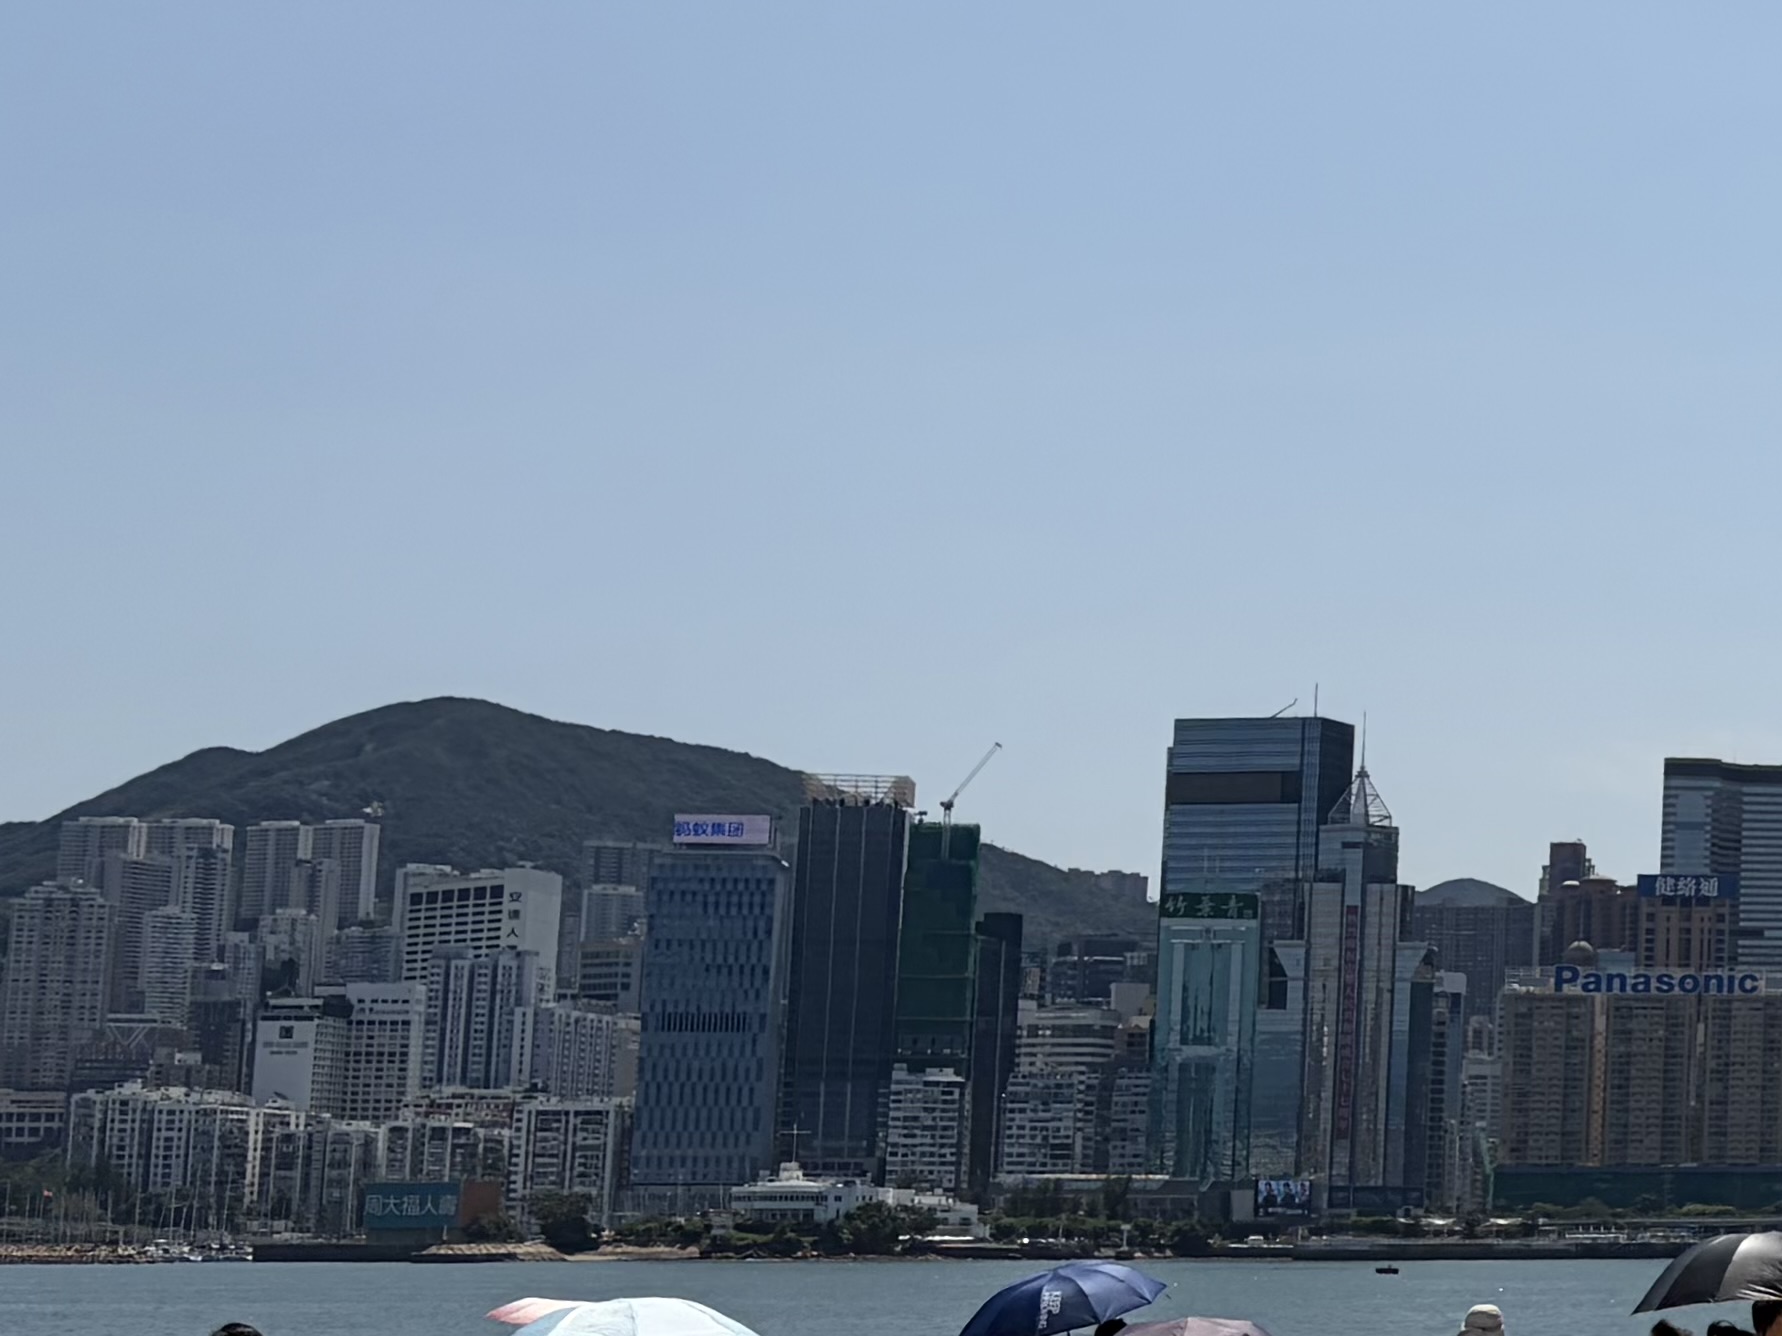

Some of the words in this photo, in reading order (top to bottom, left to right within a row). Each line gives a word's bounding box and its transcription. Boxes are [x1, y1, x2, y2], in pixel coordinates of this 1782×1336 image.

[675, 821, 743, 837] 蚂蚁集团
[1554, 965, 1759, 994] Panasonic
